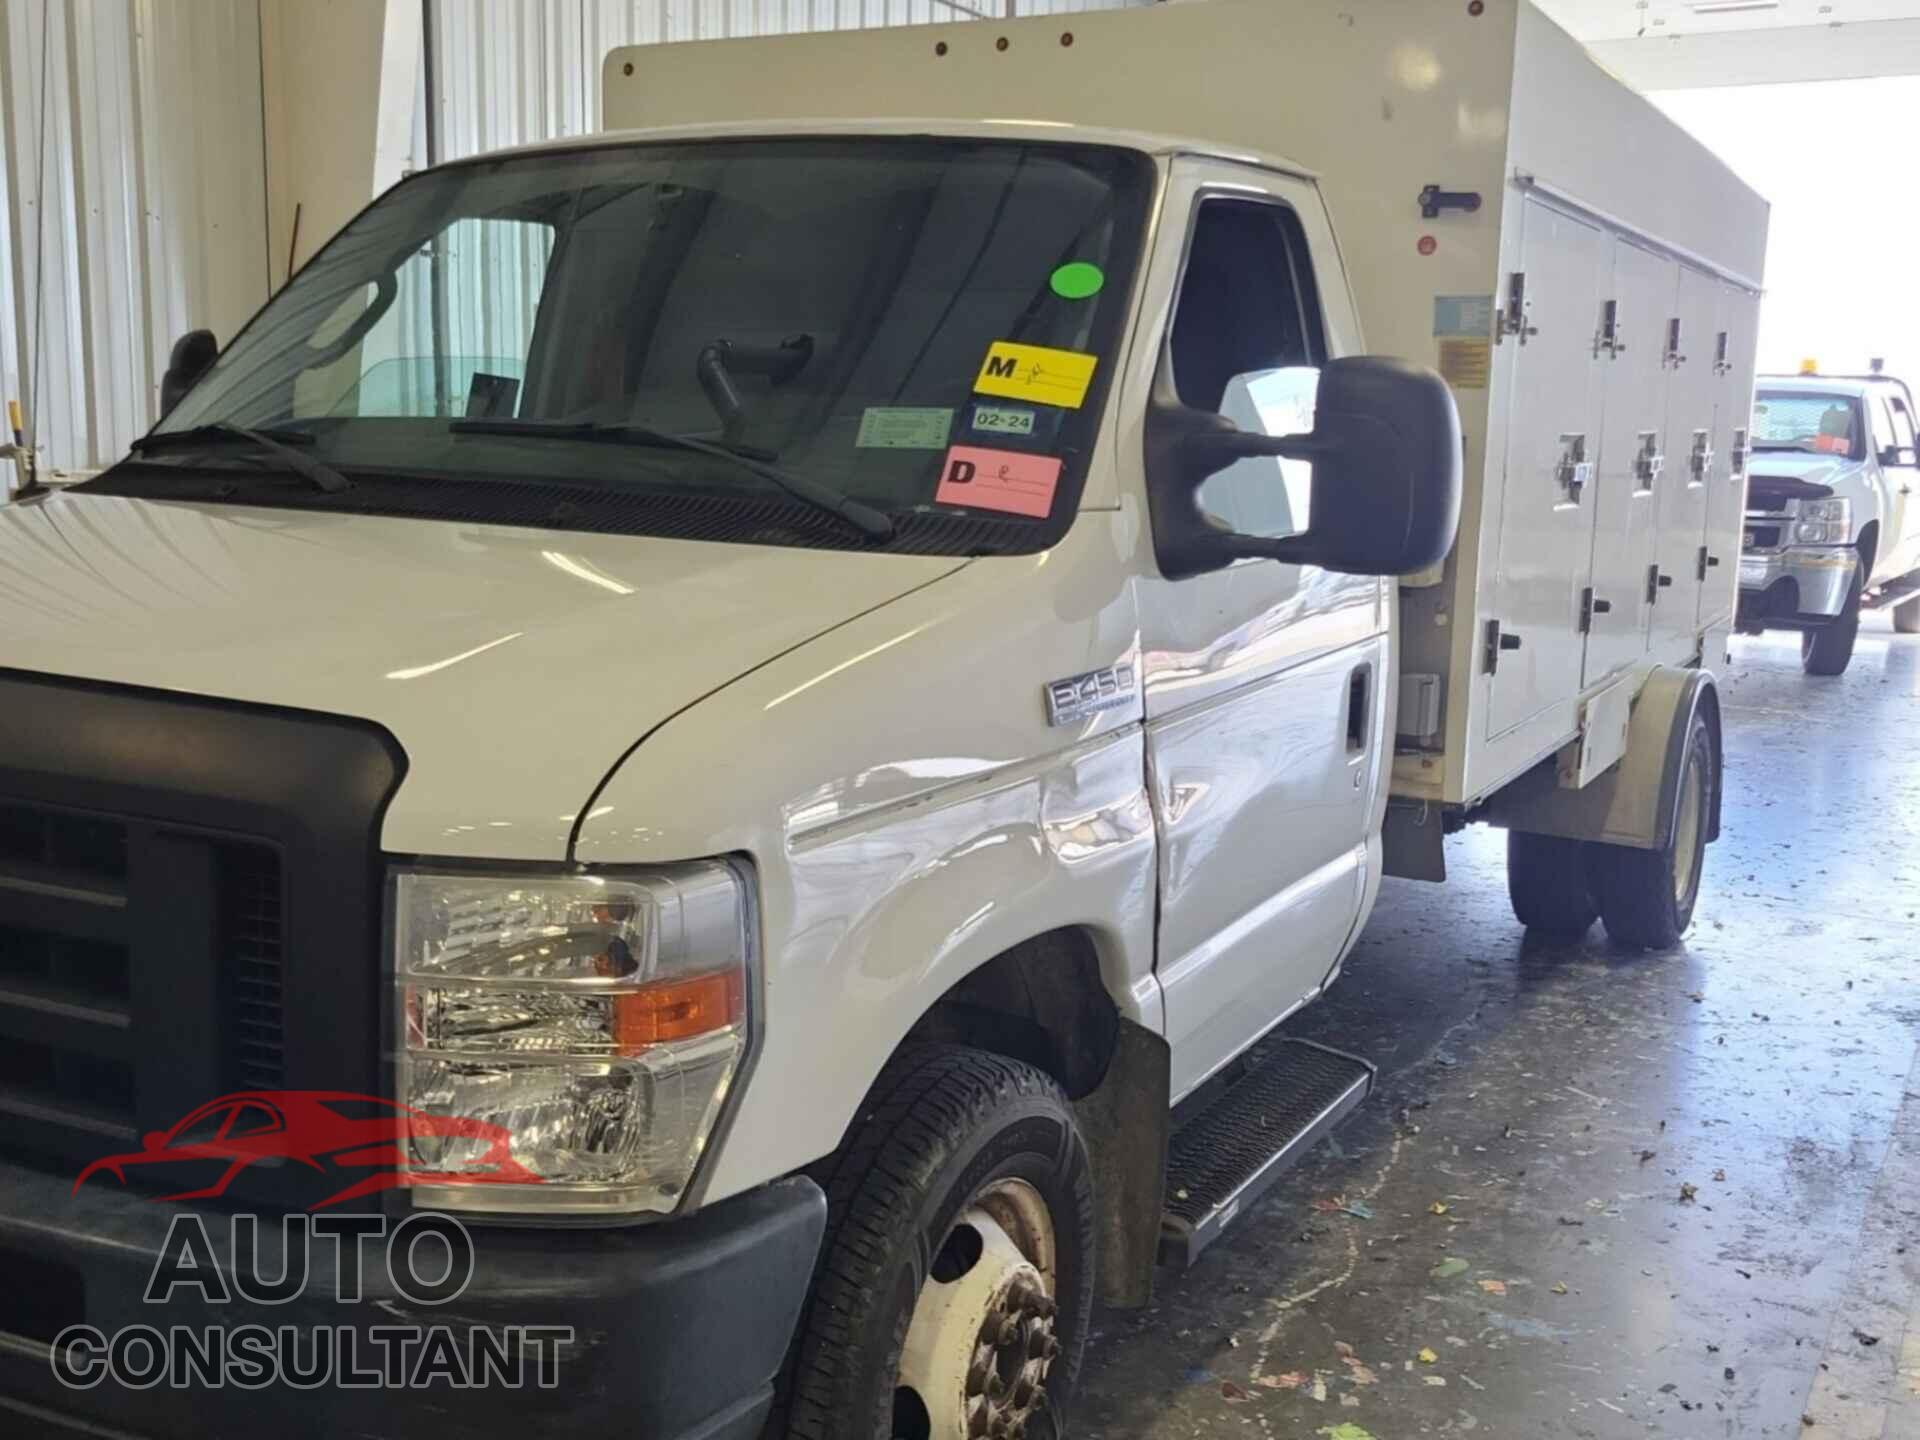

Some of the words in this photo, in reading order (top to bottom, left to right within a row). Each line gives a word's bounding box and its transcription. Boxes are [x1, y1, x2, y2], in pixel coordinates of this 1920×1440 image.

[986, 356, 1018, 378] M
[977, 413, 1030, 428] 02-24
[947, 460, 976, 484] D
